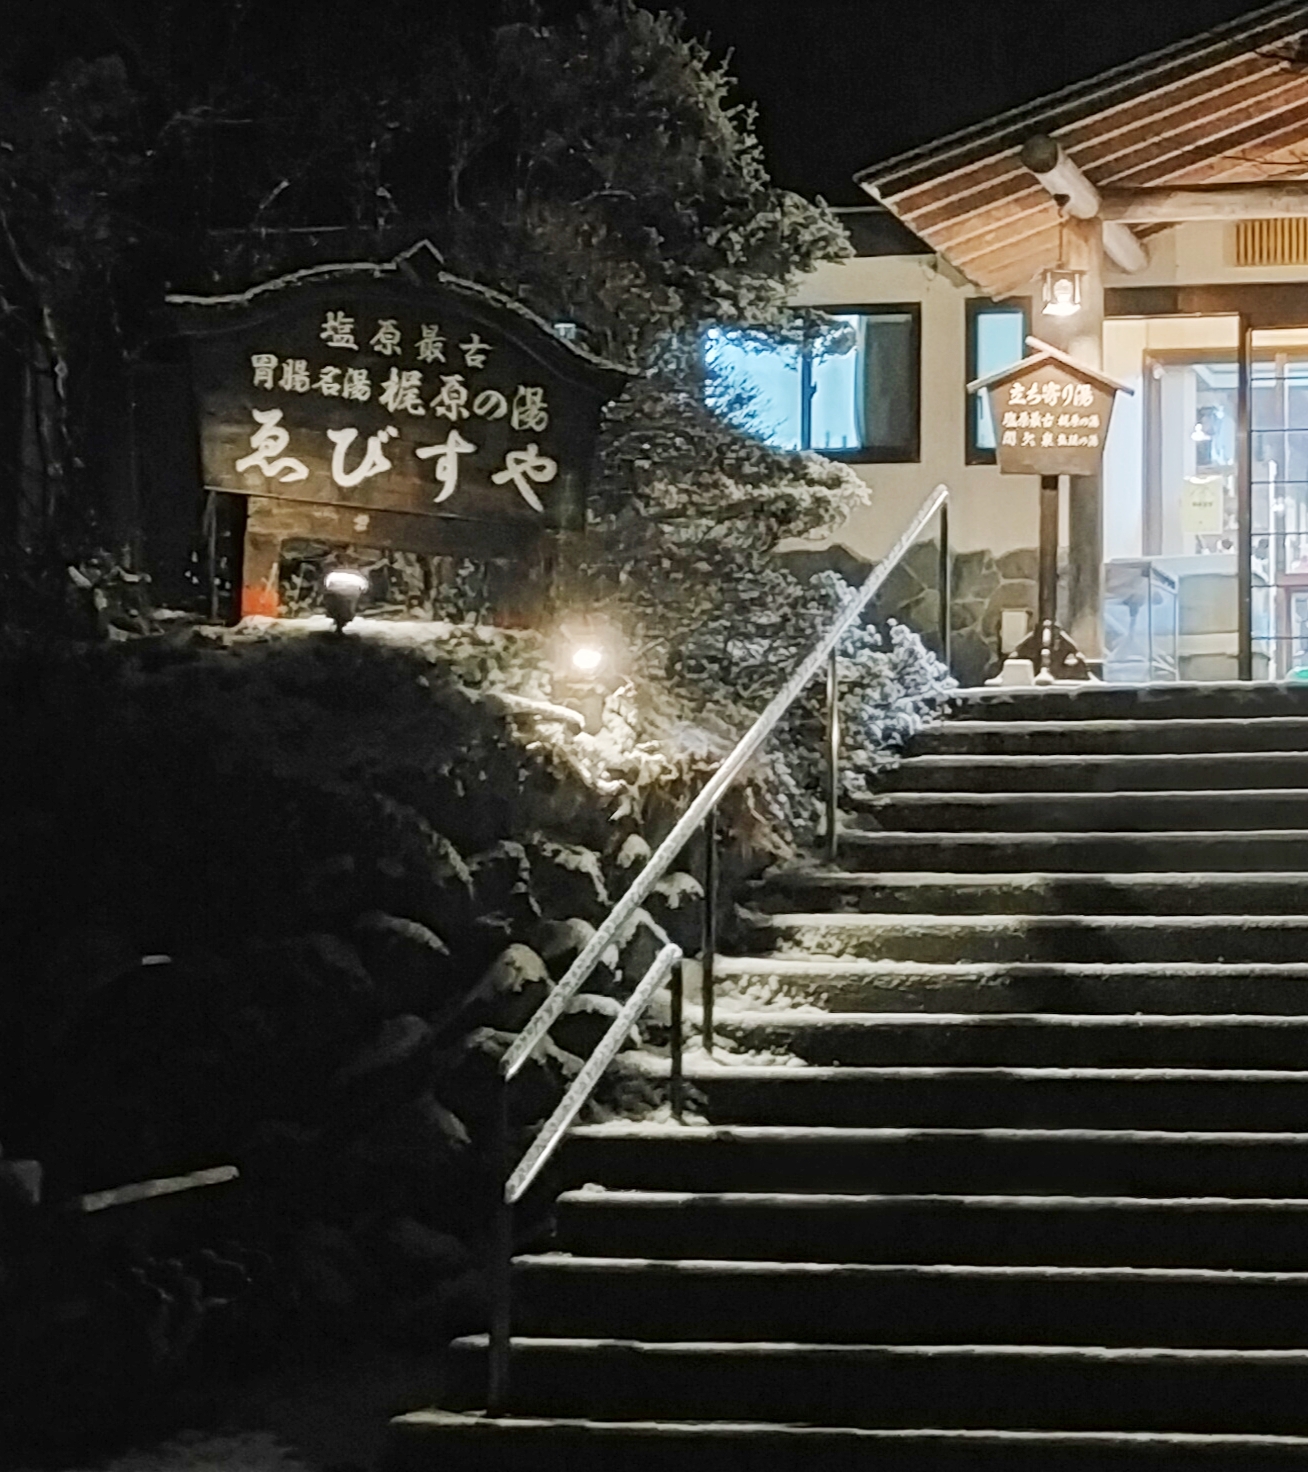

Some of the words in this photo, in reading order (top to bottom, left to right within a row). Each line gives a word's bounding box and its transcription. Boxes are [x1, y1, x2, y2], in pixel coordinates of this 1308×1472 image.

[320, 310, 494, 369] 塩原最古
[250, 353, 372, 402] 胃腸名湯
[378, 366, 549, 433] 梶原の湯
[1008, 381, 1094, 407] 立ち寄り湯
[235, 408, 558, 513] ゑびすや
